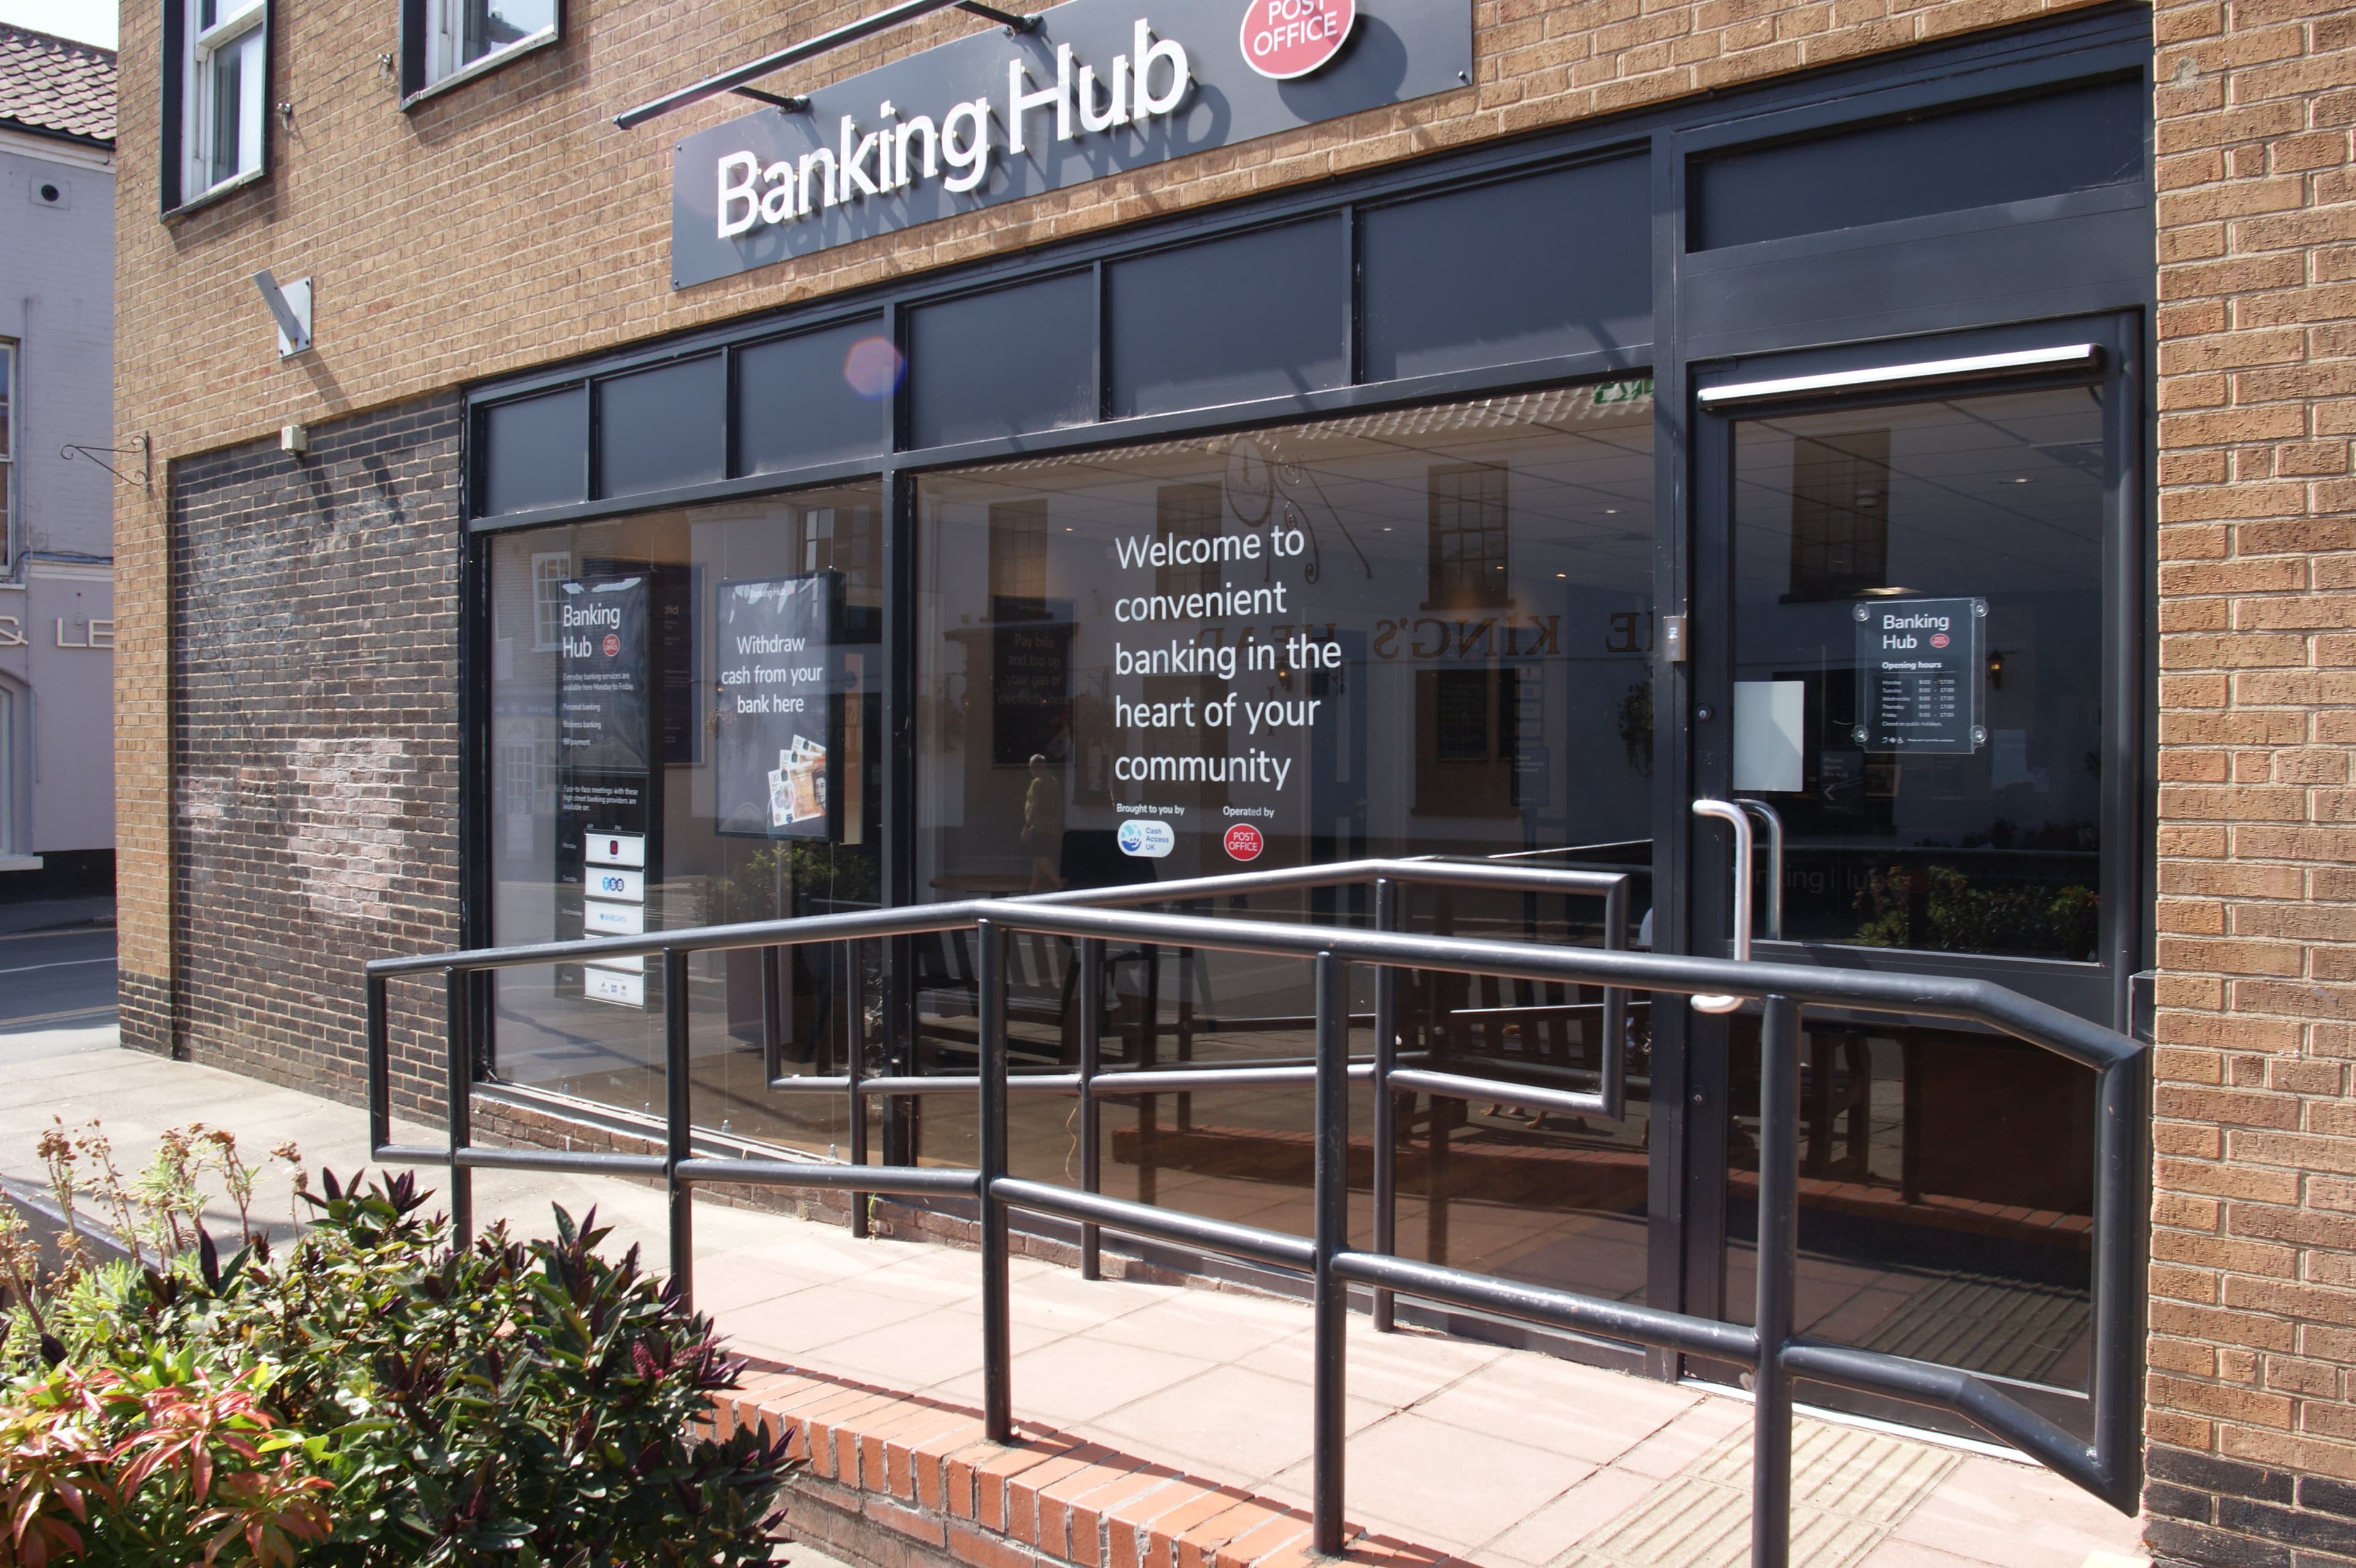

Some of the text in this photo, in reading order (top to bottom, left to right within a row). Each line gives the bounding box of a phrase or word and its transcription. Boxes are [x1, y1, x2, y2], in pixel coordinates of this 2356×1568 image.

[1253, 11, 1338, 56] OFFICE
[718, 18, 1188, 238] Banking Hub
[1115, 525, 1305, 569] Welcome to
[1115, 582, 1287, 622] convenient
[563, 602, 620, 629] Banking
[1883, 614, 1949, 631] Banking
[563, 635, 592, 658] Hub
[736, 634, 805, 655] Withdraw
[1014, 634, 1055, 648] Pay bills
[1883, 634, 1917, 649] Hub
[1007, 653, 1027, 666] and
[1047, 656, 1061, 667] up
[1115, 634, 1341, 680] banking in the
[1882, 661, 1916, 670] Opening
[721, 664, 823, 686] cash from your
[1031, 676, 1049, 688] gas
[737, 694, 804, 713] bank here
[1115, 692, 1321, 734] heart of your
[1115, 748, 1292, 791] community
[1117, 803, 1185, 816] Brought to you by
[1223, 806, 1275, 818] Operated by
[1228, 841, 1258, 851] OFFICE
[1233, 832, 1255, 841] POST
[603, 878, 623, 891] TSB
